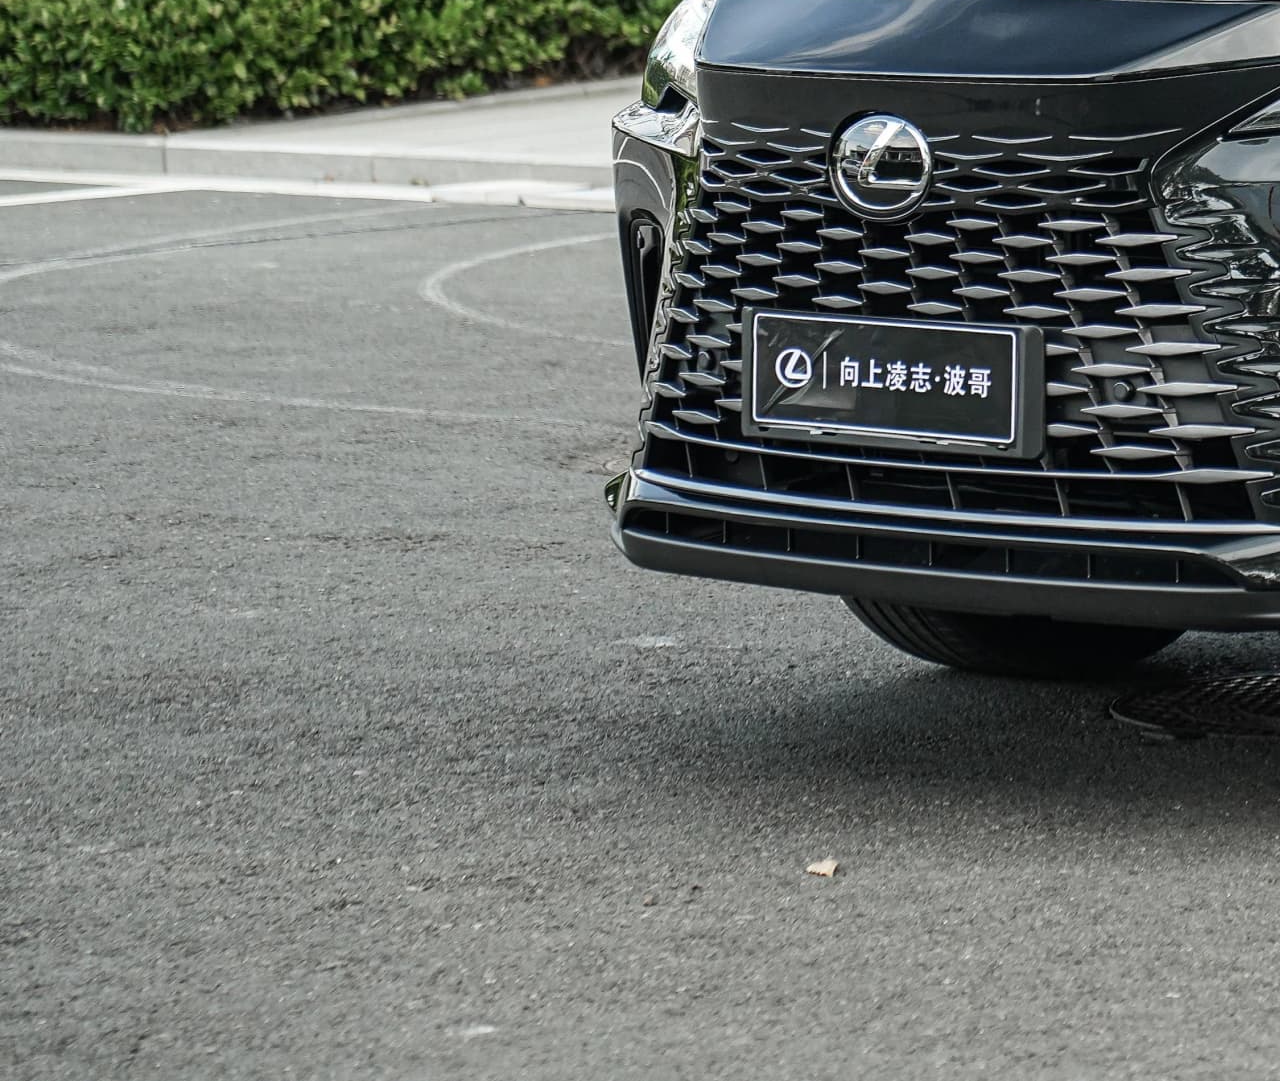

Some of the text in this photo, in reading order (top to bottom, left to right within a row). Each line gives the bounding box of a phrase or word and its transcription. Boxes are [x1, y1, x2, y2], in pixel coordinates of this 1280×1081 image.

[839, 356, 992, 399] 向上凌志·波哥
